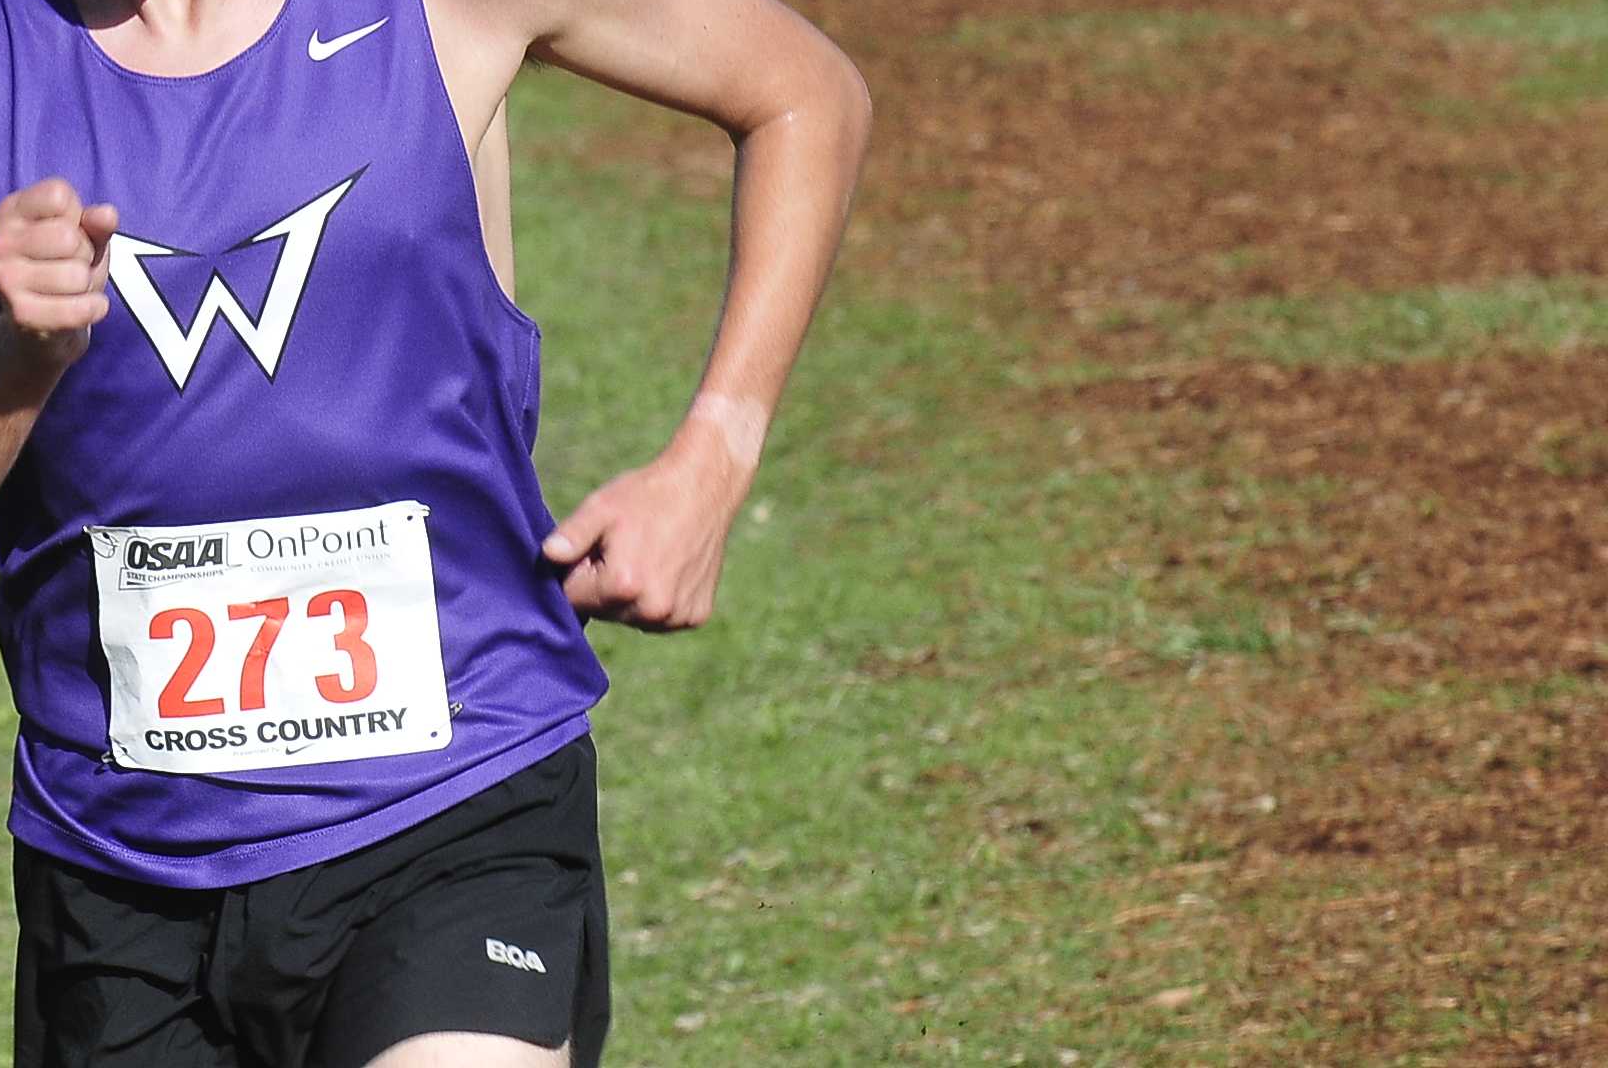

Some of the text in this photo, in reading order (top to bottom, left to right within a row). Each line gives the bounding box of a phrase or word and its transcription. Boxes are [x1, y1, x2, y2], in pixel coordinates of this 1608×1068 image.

[126, 537, 223, 571] OSAA
[247, 519, 389, 559] OnPoint
[126, 569, 224, 583] STATE CHAMPIONSHIPS
[149, 589, 378, 719] 273
[144, 707, 408, 752] CROSS COUNTRY
[485, 938, 547, 973] BOA
